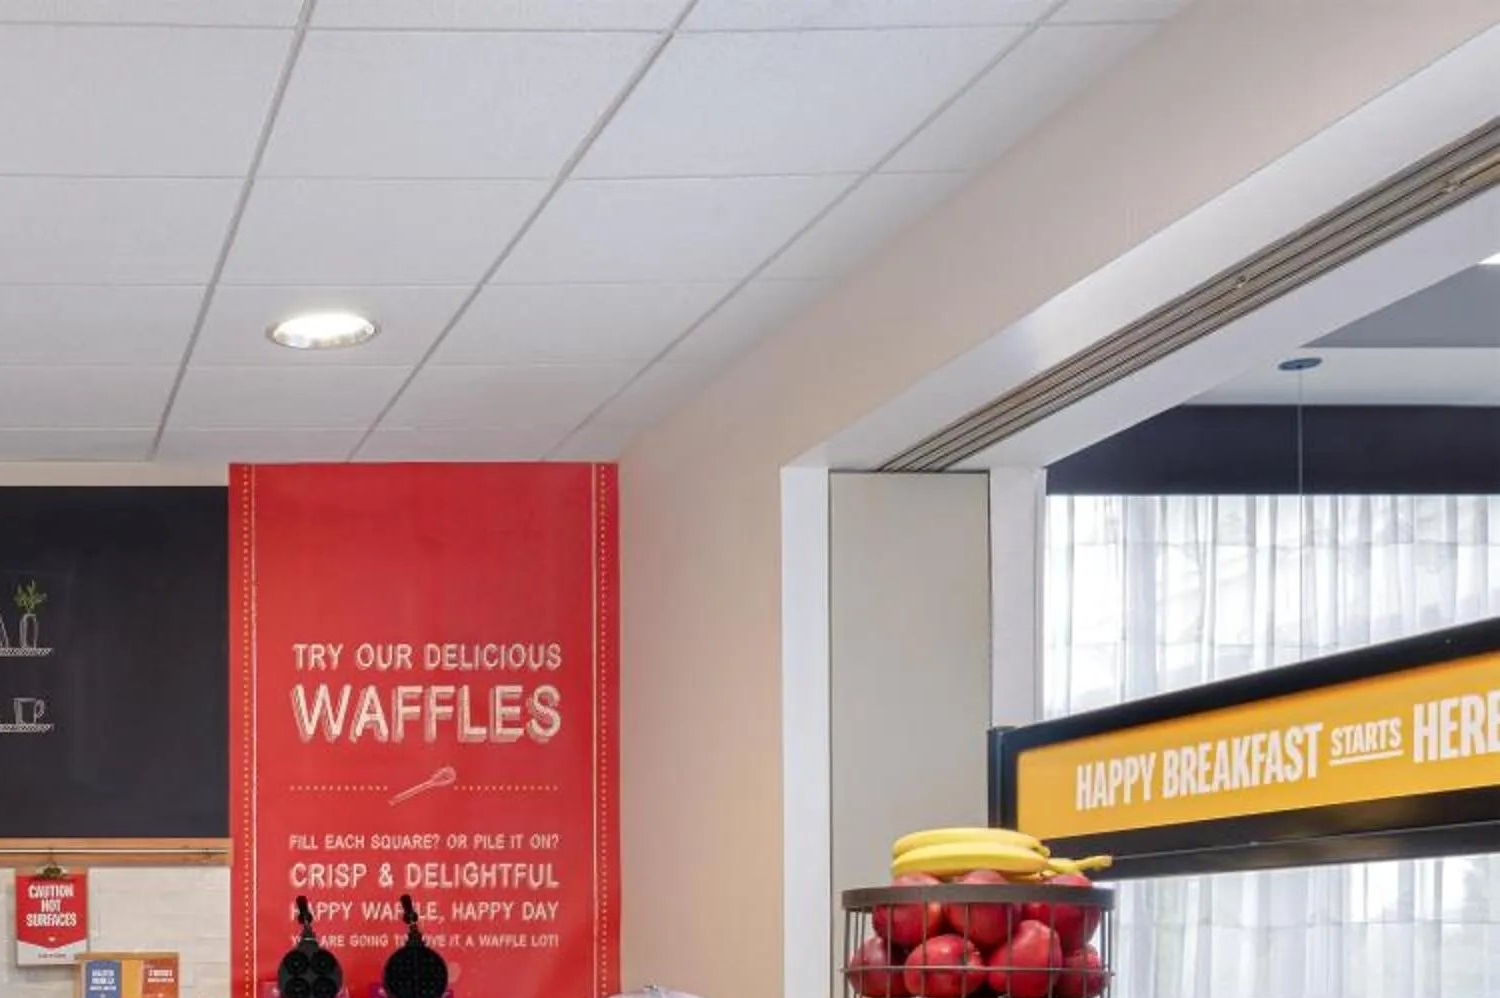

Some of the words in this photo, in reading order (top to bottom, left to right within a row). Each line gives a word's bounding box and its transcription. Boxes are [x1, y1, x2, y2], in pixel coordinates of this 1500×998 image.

[293, 643, 344, 671] TRY
[355, 642, 414, 671] OUR
[423, 642, 562, 671] DELICIOUS
[290, 683, 562, 744] WAFFLES
[1076, 751, 1157, 811] HAPPY
[1162, 722, 1323, 799] BREAKFAST
[1330, 717, 1403, 757] STARTS
[289, 834, 319, 850] FILL
[324, 833, 366, 850] EACH
[370, 833, 440, 850] SQUARE?
[446, 833, 468, 850] OR
[473, 833, 505, 850] PILE
[510, 833, 525, 849] IT
[530, 832, 560, 850] ON?
[290, 861, 368, 889] CRISP
[379, 861, 394, 888] &
[405, 861, 560, 889] DELIGHTFUL
[28, 883, 75, 899] CAUTION
[41, 899, 62, 913] HOT
[361, 901, 446, 924] WAFLE,
[451, 901, 515, 920] HAPPY
[522, 901, 560, 920] DAY
[26, 913, 77, 928] SURFACES
[320, 935, 345, 947] ARE
[349, 935, 389, 948] GOING
[465, 934, 475, 947] A
[479, 934, 527, 947] WAFFLE
[531, 934, 559, 947] LOT!
